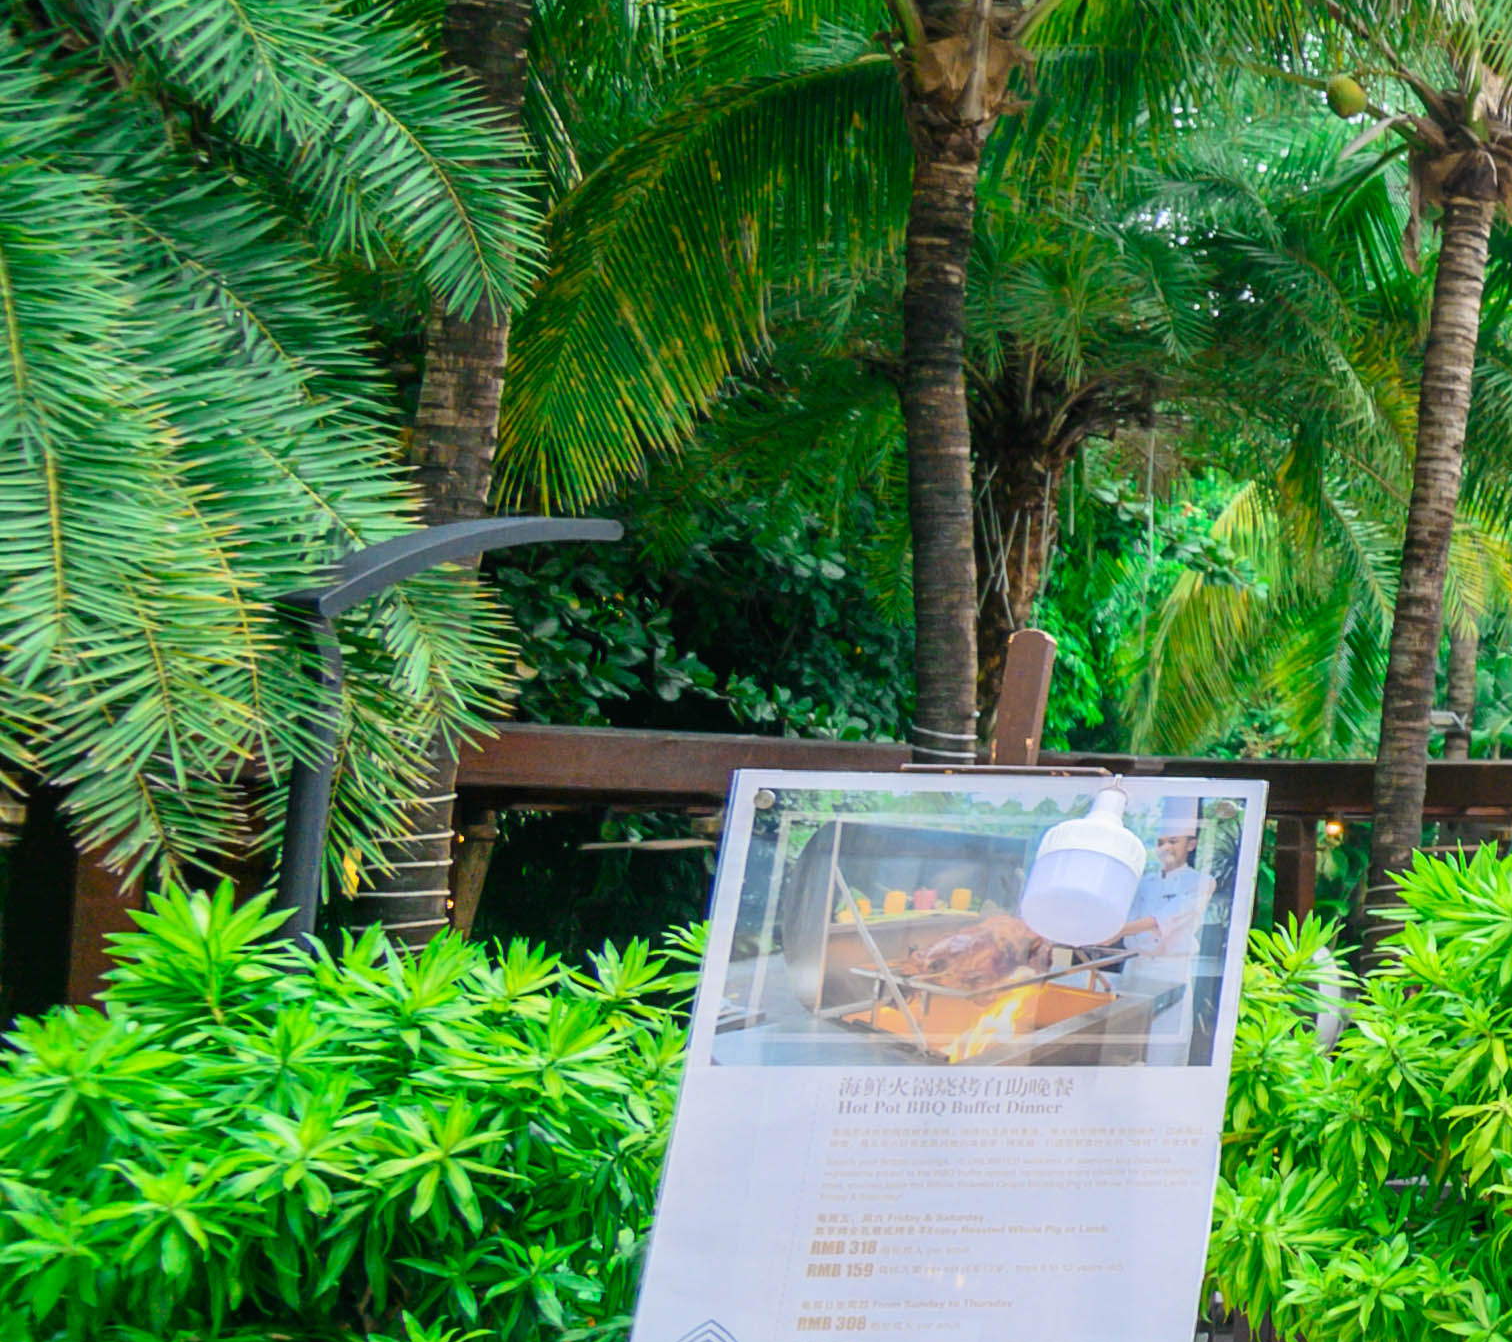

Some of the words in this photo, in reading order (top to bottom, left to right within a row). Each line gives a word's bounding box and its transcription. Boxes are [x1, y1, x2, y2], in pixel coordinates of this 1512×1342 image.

[837, 1099, 868, 1115] Hot
[873, 1099, 901, 1115] Pot
[906, 1099, 946, 1116] BBQ
[950, 1099, 1001, 1115] Buffet
[1005, 1099, 1063, 1115] Dinner
[809, 1239, 846, 1256] RMB
[849, 1239, 878, 1255] 318
[806, 1262, 842, 1278] RMB
[846, 1262, 875, 1278] 159
[796, 1315, 832, 1332] RMB
